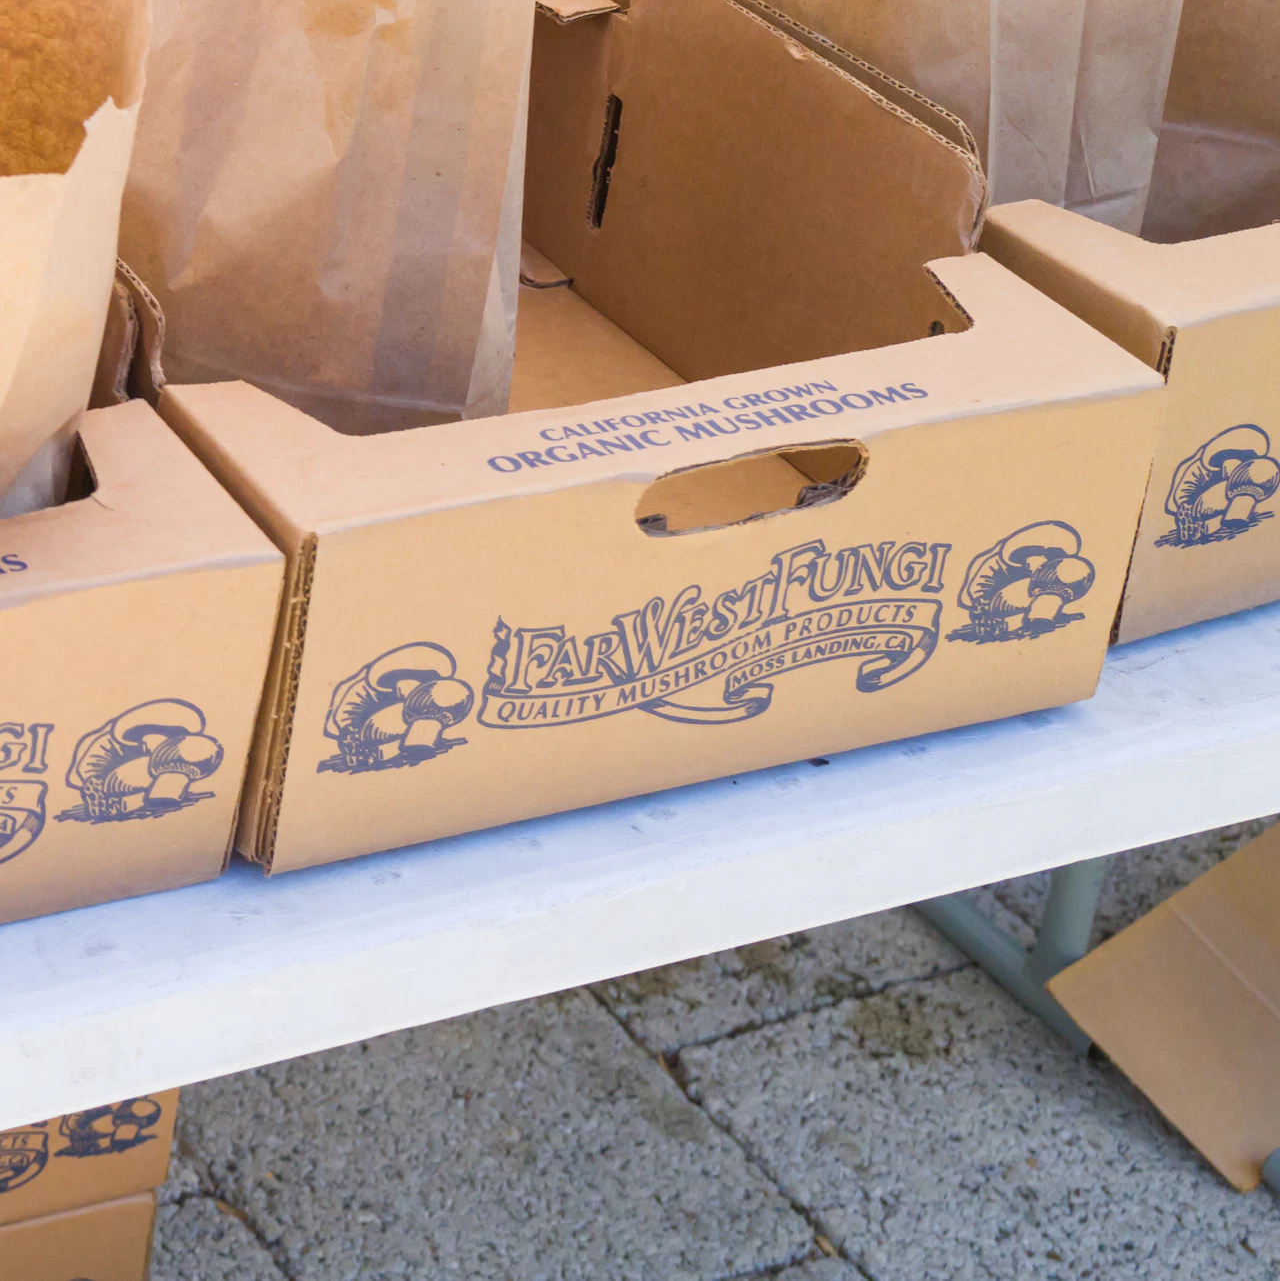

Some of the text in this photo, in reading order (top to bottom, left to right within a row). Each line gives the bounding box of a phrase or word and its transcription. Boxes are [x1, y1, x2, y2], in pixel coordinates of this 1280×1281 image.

[487, 381, 930, 474] ORGANIC MUSHROOMS
[539, 379, 840, 443] CALIFORNIA GROWN
[496, 604, 918, 722] QUALITY MUSHROOM PRODUCTS
[731, 655, 787, 689] MOSS
[883, 634, 906, 651] CA
